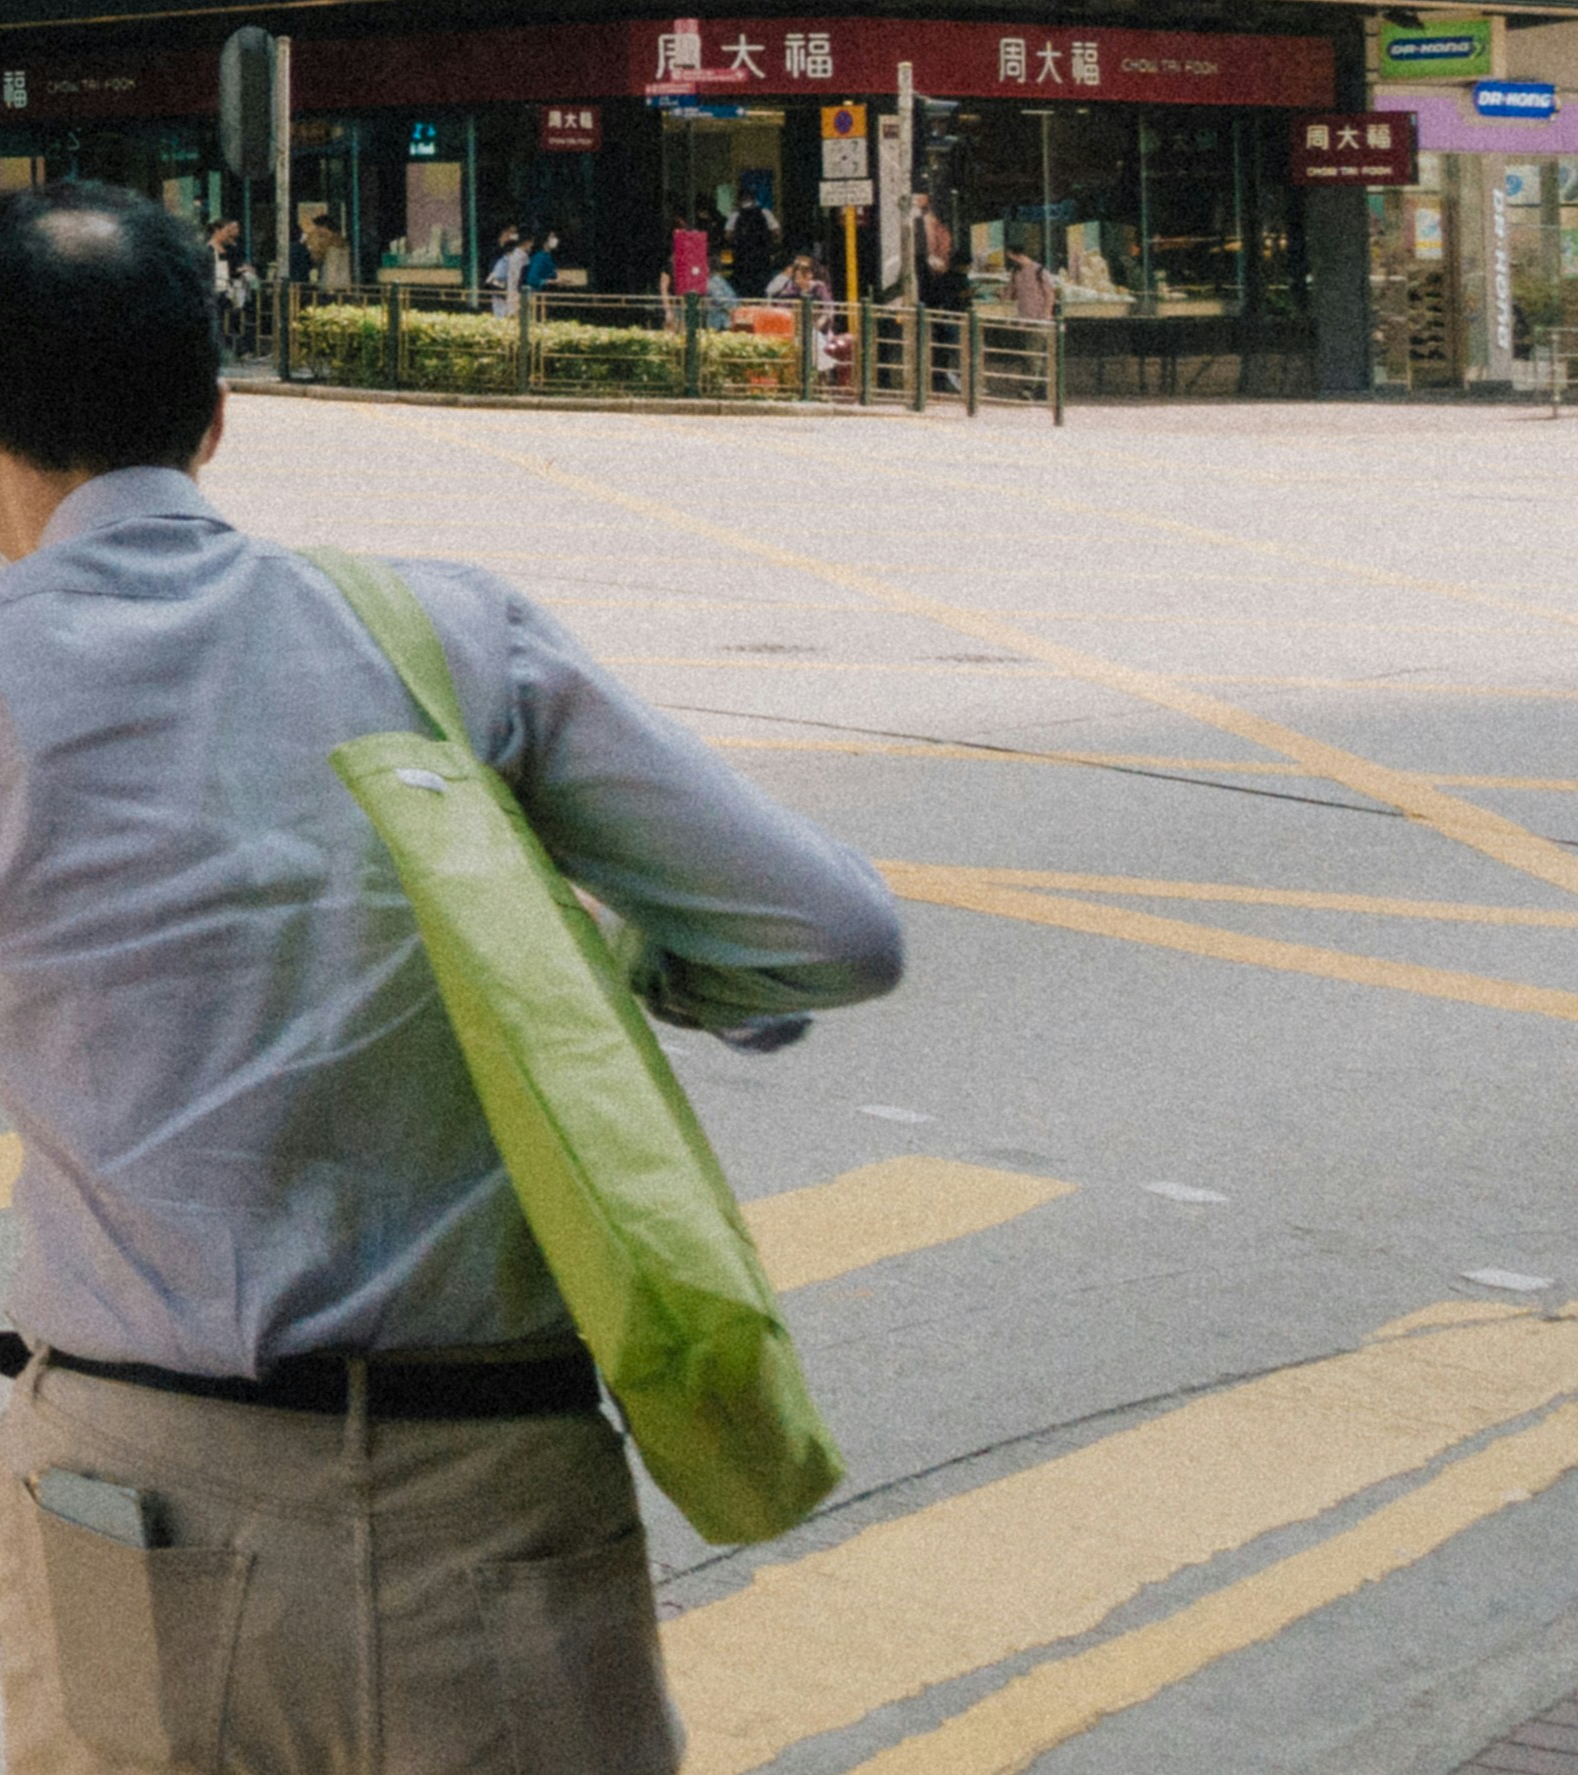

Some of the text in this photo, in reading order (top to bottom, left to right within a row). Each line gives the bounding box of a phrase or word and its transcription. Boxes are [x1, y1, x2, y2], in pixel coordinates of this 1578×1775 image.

[656, 33, 833, 80] 周大福
[999, 38, 1100, 85] 周大福
[1121, 58, 1159, 73] CHOW
[1306, 124, 1392, 150] 周大福
[1306, 166, 1337, 177] CHOW
[1362, 166, 1393, 178] FOOK
